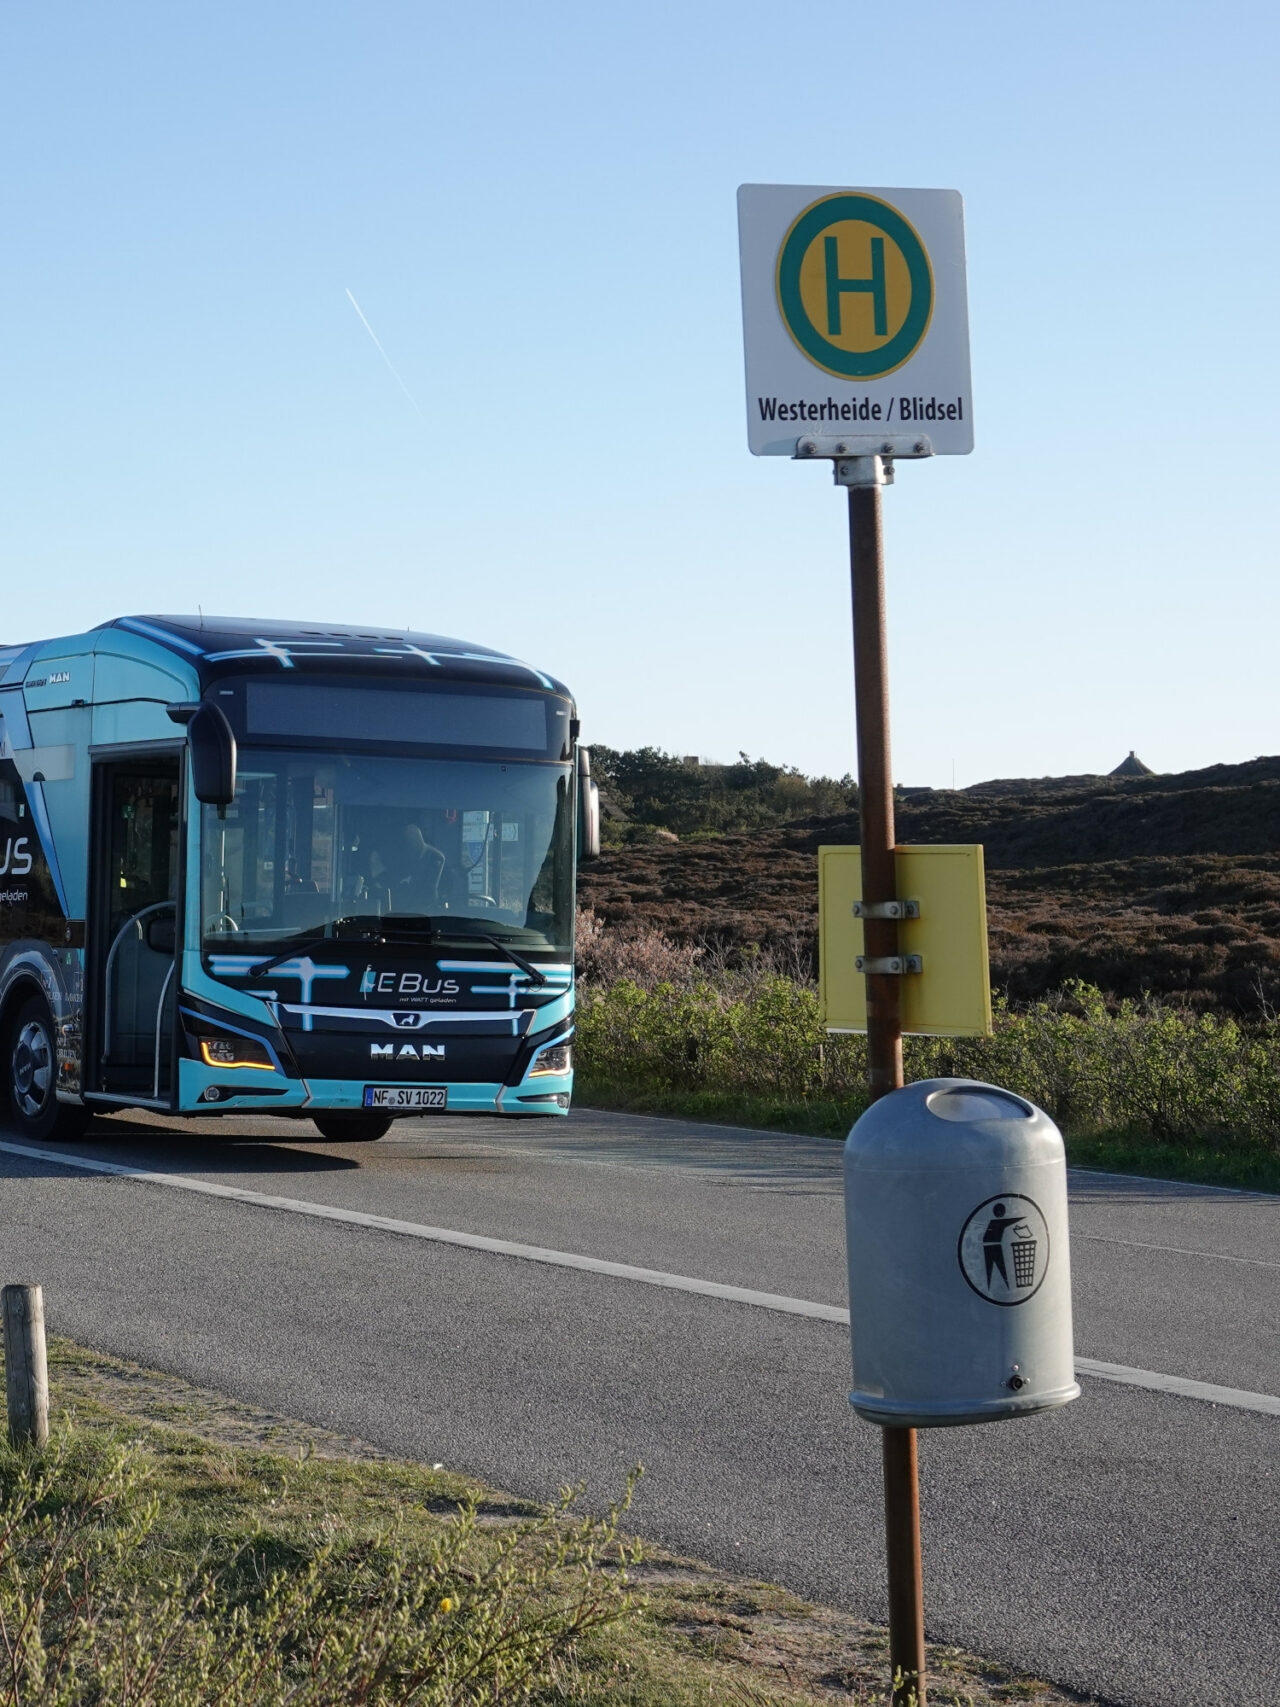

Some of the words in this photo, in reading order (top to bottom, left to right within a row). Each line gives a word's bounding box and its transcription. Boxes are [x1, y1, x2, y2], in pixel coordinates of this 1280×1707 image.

[824, 236, 888, 336] H
[758, 397, 882, 421] Westerheide
[886, 397, 894, 422] /
[899, 396, 963, 421] Blidsel
[49, 671, 70, 684] MAN
[370, 1043, 446, 1061] MAN
[373, 1090, 389, 1105] NF
[397, 1090, 412, 1105] SV
[415, 1091, 445, 1106] 1022
